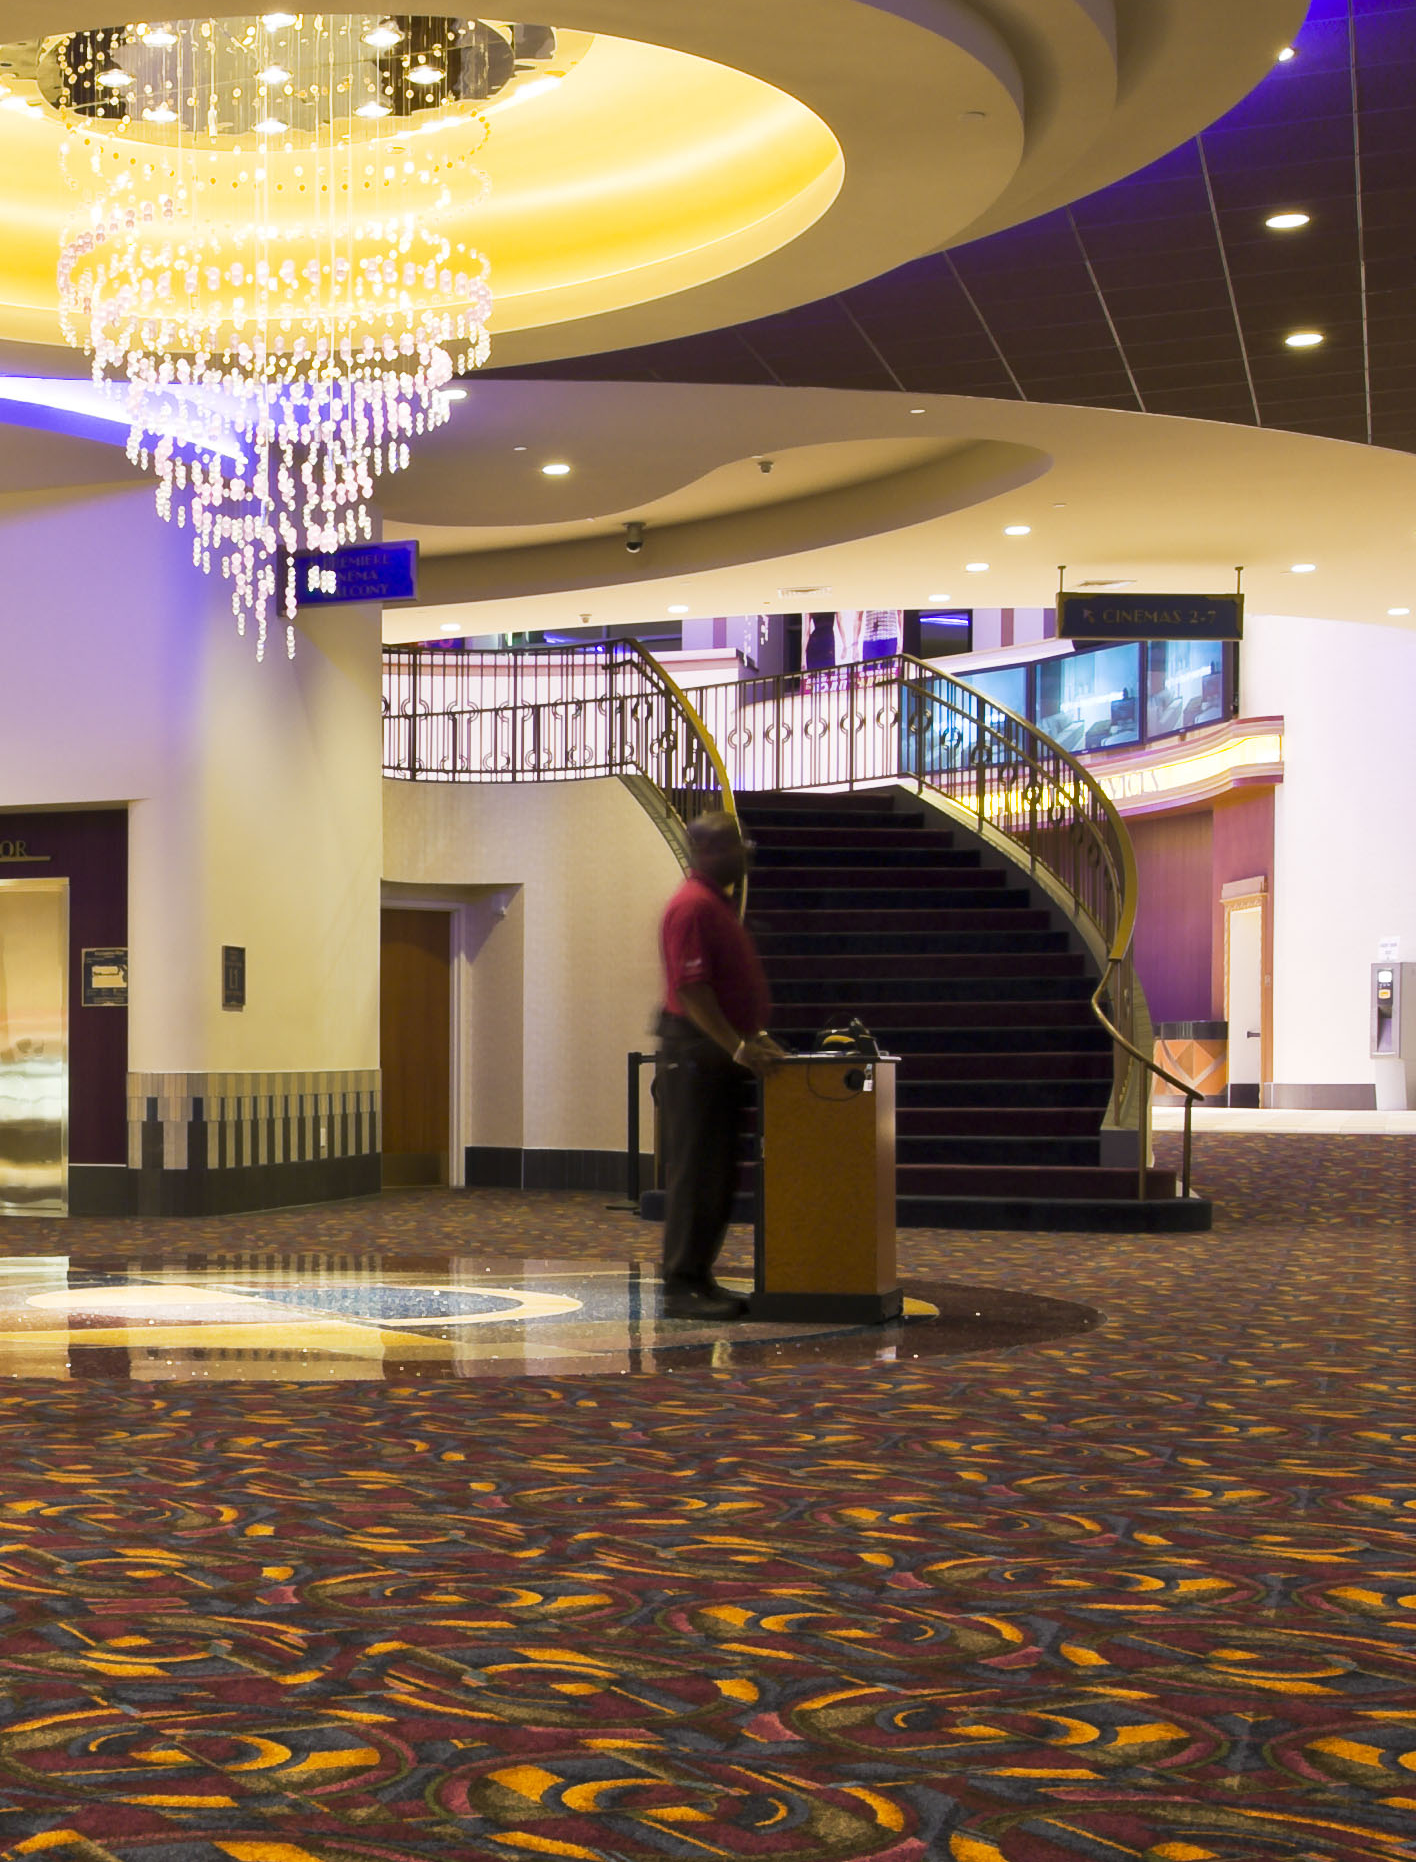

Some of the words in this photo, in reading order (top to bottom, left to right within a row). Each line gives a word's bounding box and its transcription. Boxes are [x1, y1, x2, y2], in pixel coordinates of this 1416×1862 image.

[329, 583, 390, 597] ALCONY
[1102, 609, 1182, 624] CINEMAS
[1188, 609, 1217, 624] 2-7
